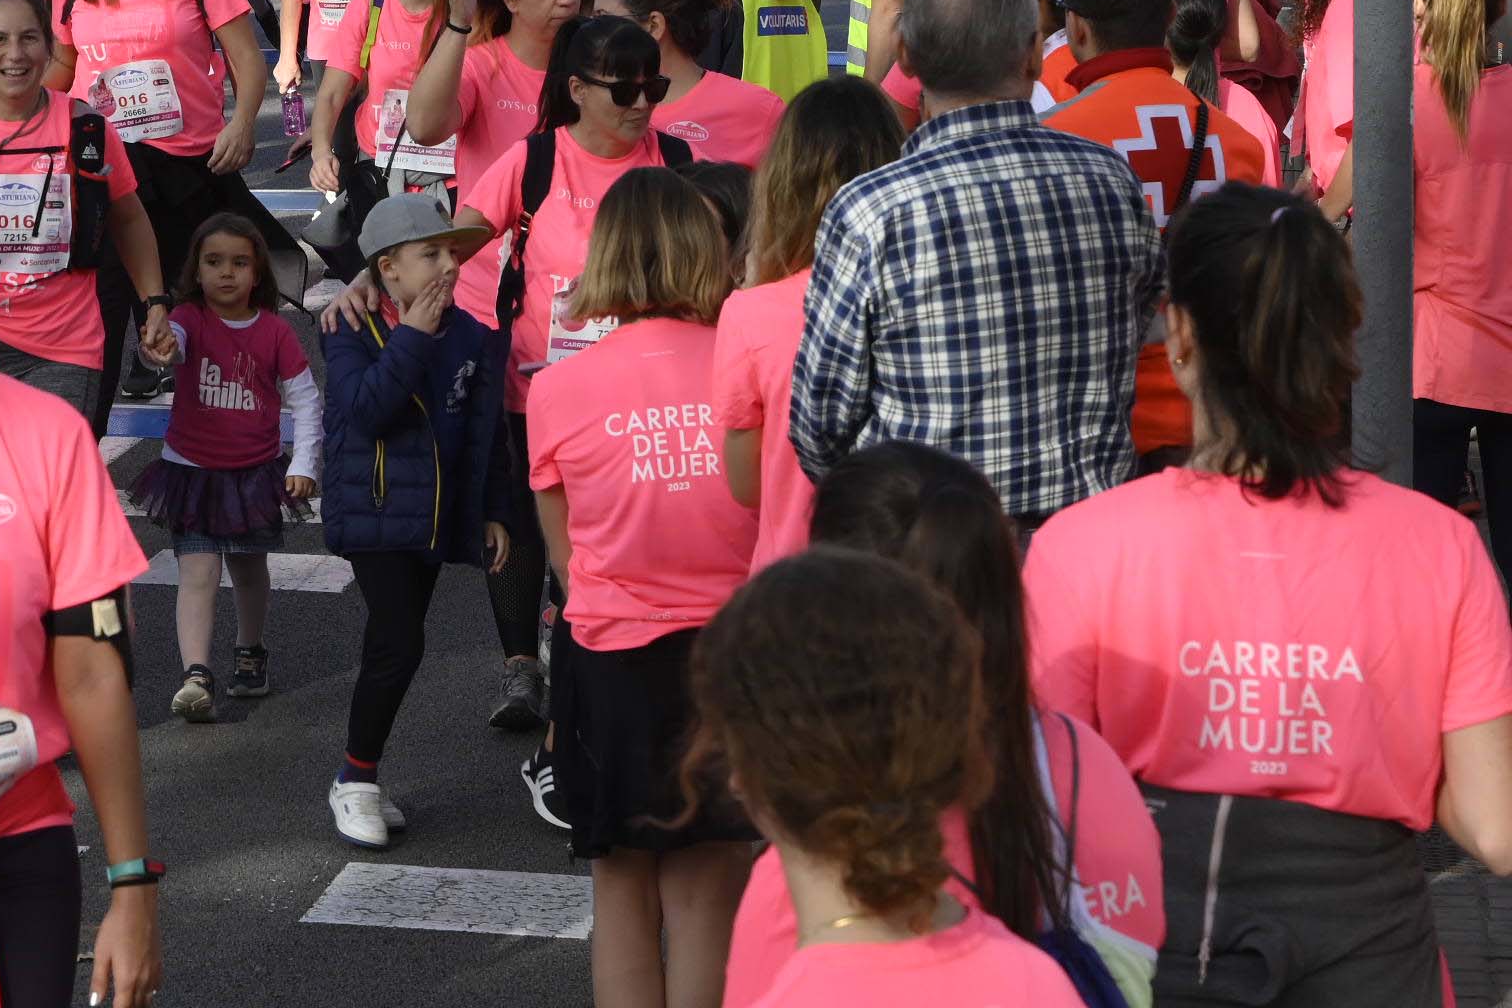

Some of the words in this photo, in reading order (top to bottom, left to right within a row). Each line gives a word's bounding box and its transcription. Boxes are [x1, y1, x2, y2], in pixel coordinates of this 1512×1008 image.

[82, 43, 107, 62] TU
[118, 92, 148, 107] 016
[3, 232, 29, 243] 7215
[3, 244, 13, 252] DE
[14, 244, 23, 252] LA
[199, 357, 221, 387] la
[198, 380, 256, 412] milla
[604, 402, 716, 437] CARRER
[632, 431, 668, 458] DE
[679, 428, 714, 453] LA
[631, 452, 720, 484] MUJER
[667, 481, 691, 492] 2023
[1179, 640, 1364, 682] CARRERA
[1207, 679, 1261, 715] DE
[1278, 682, 1327, 717] LA
[1198, 717, 1335, 756] MUJER
[1250, 761, 1288, 775] 2023
